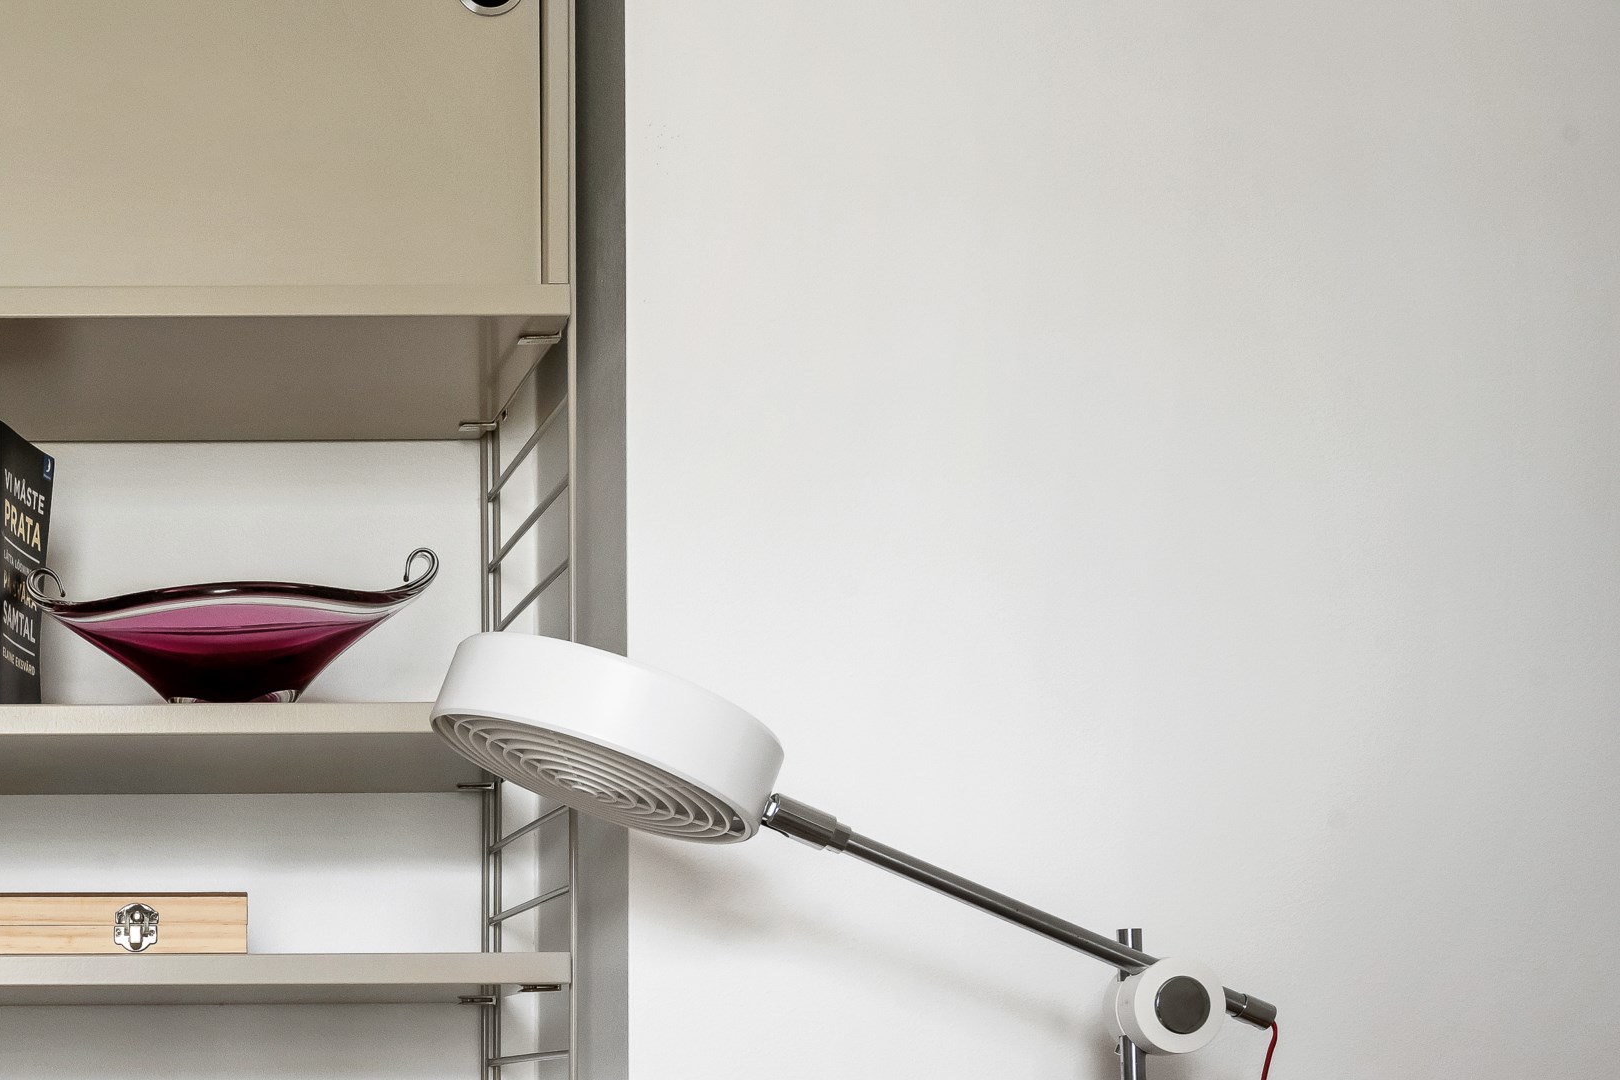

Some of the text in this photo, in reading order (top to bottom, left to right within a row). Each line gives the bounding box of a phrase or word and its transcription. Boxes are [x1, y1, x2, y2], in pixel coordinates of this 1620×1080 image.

[4, 468, 45, 515] VI MÅSTE
[4, 498, 41, 551] PRATA
[3, 600, 36, 643] SAMTAL
[2, 646, 14, 665] ELAINE
